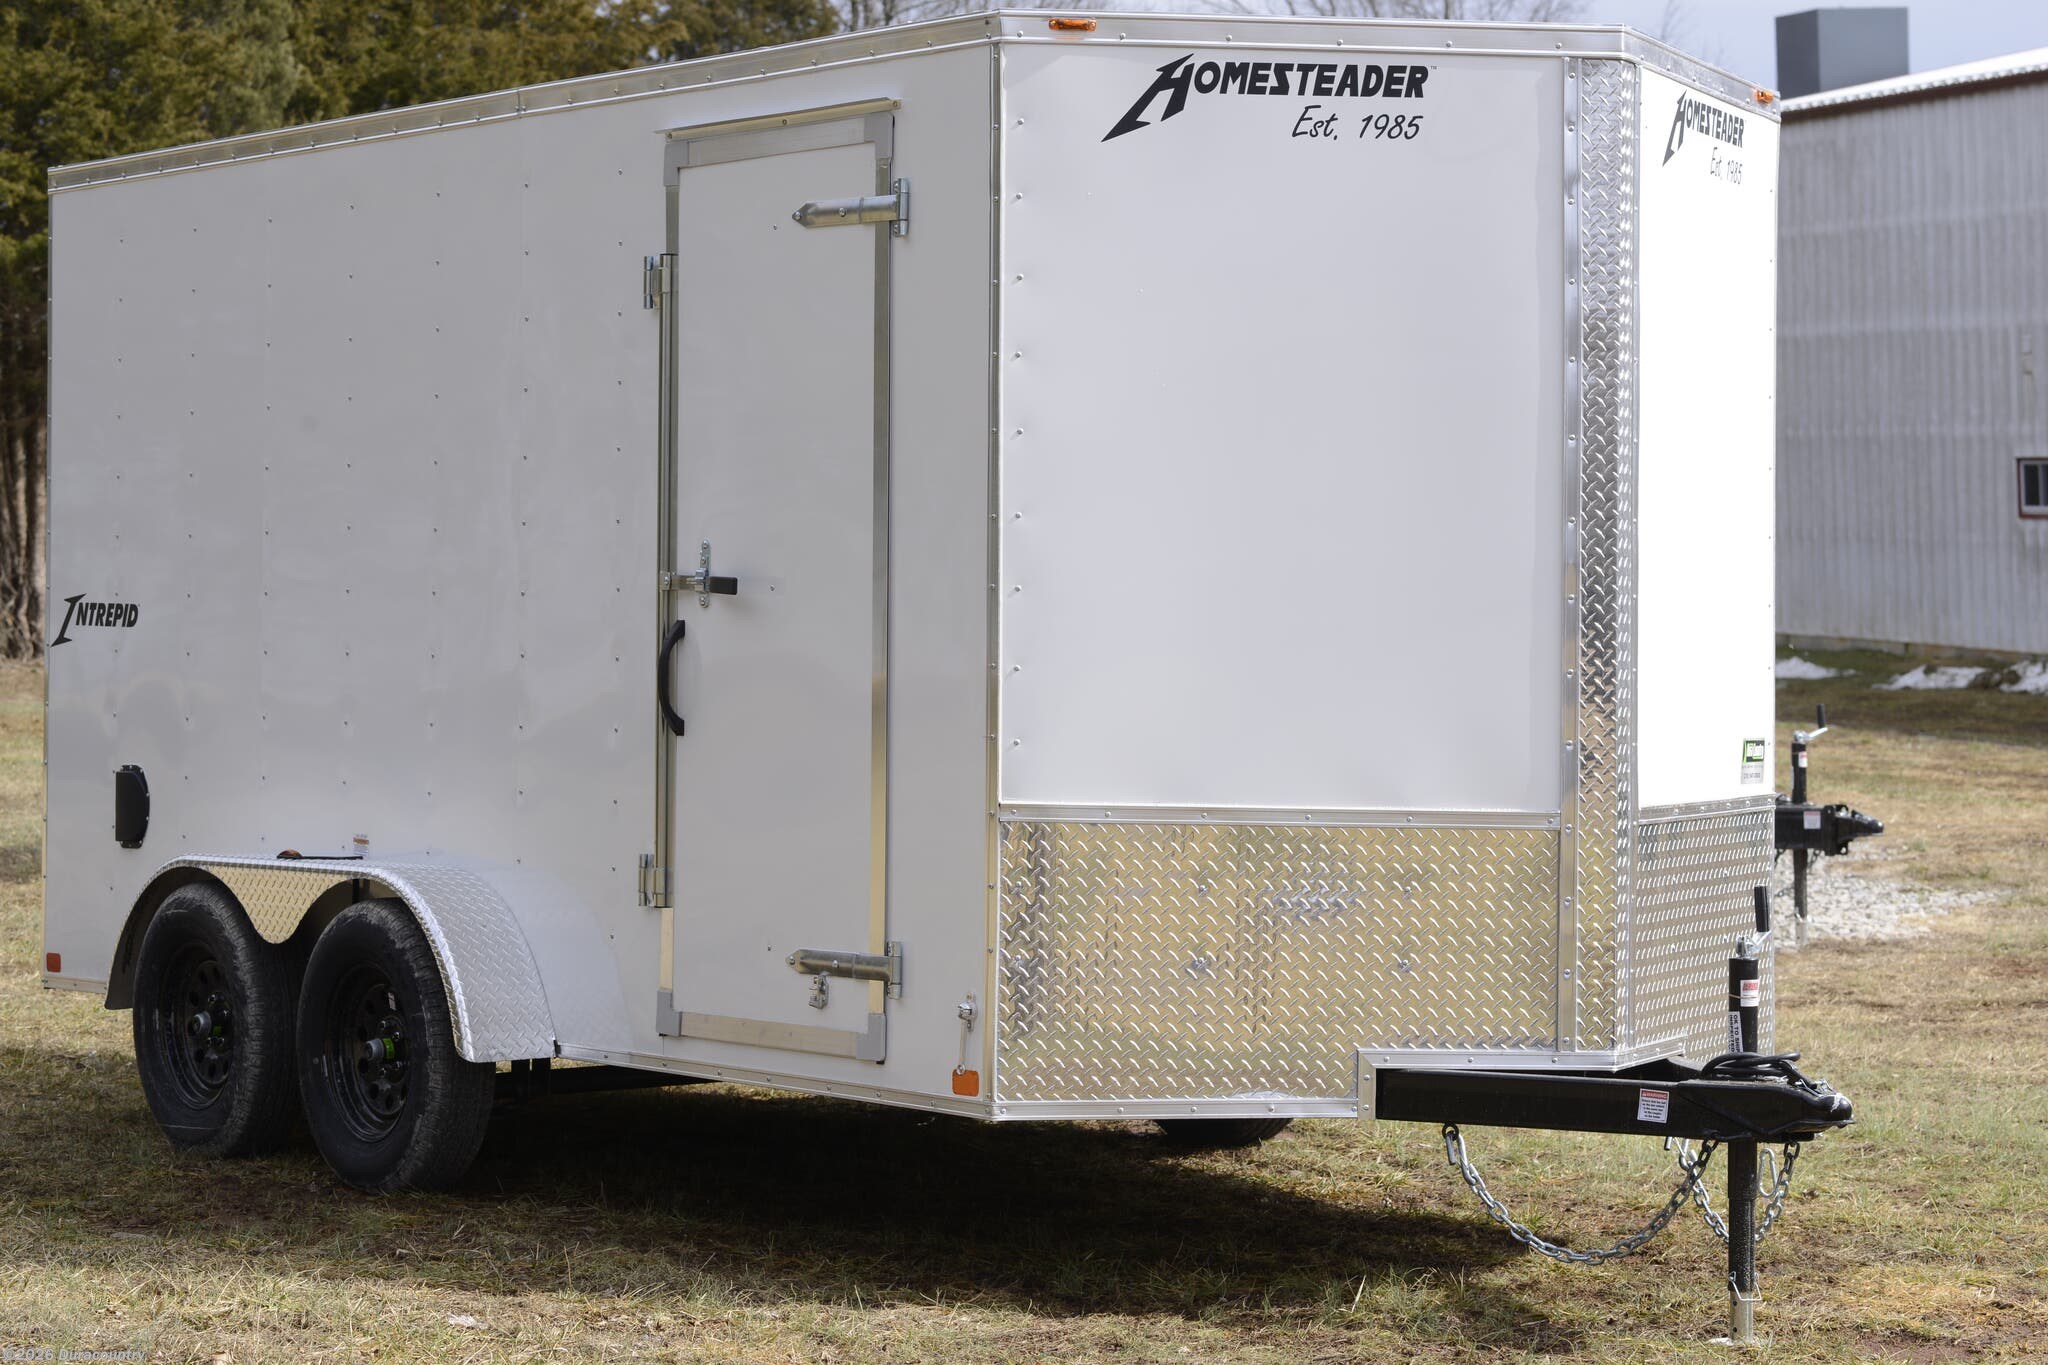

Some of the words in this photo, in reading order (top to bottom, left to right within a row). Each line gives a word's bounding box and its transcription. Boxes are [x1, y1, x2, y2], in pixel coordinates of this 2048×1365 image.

[1101, 53, 1429, 142] HOMESTEADER
[1359, 115, 1424, 140] 1985
[1662, 89, 1745, 167] HOMESTEADER
[50, 593, 139, 648] INTREPID
[1734, 1026, 1739, 1036] TO
